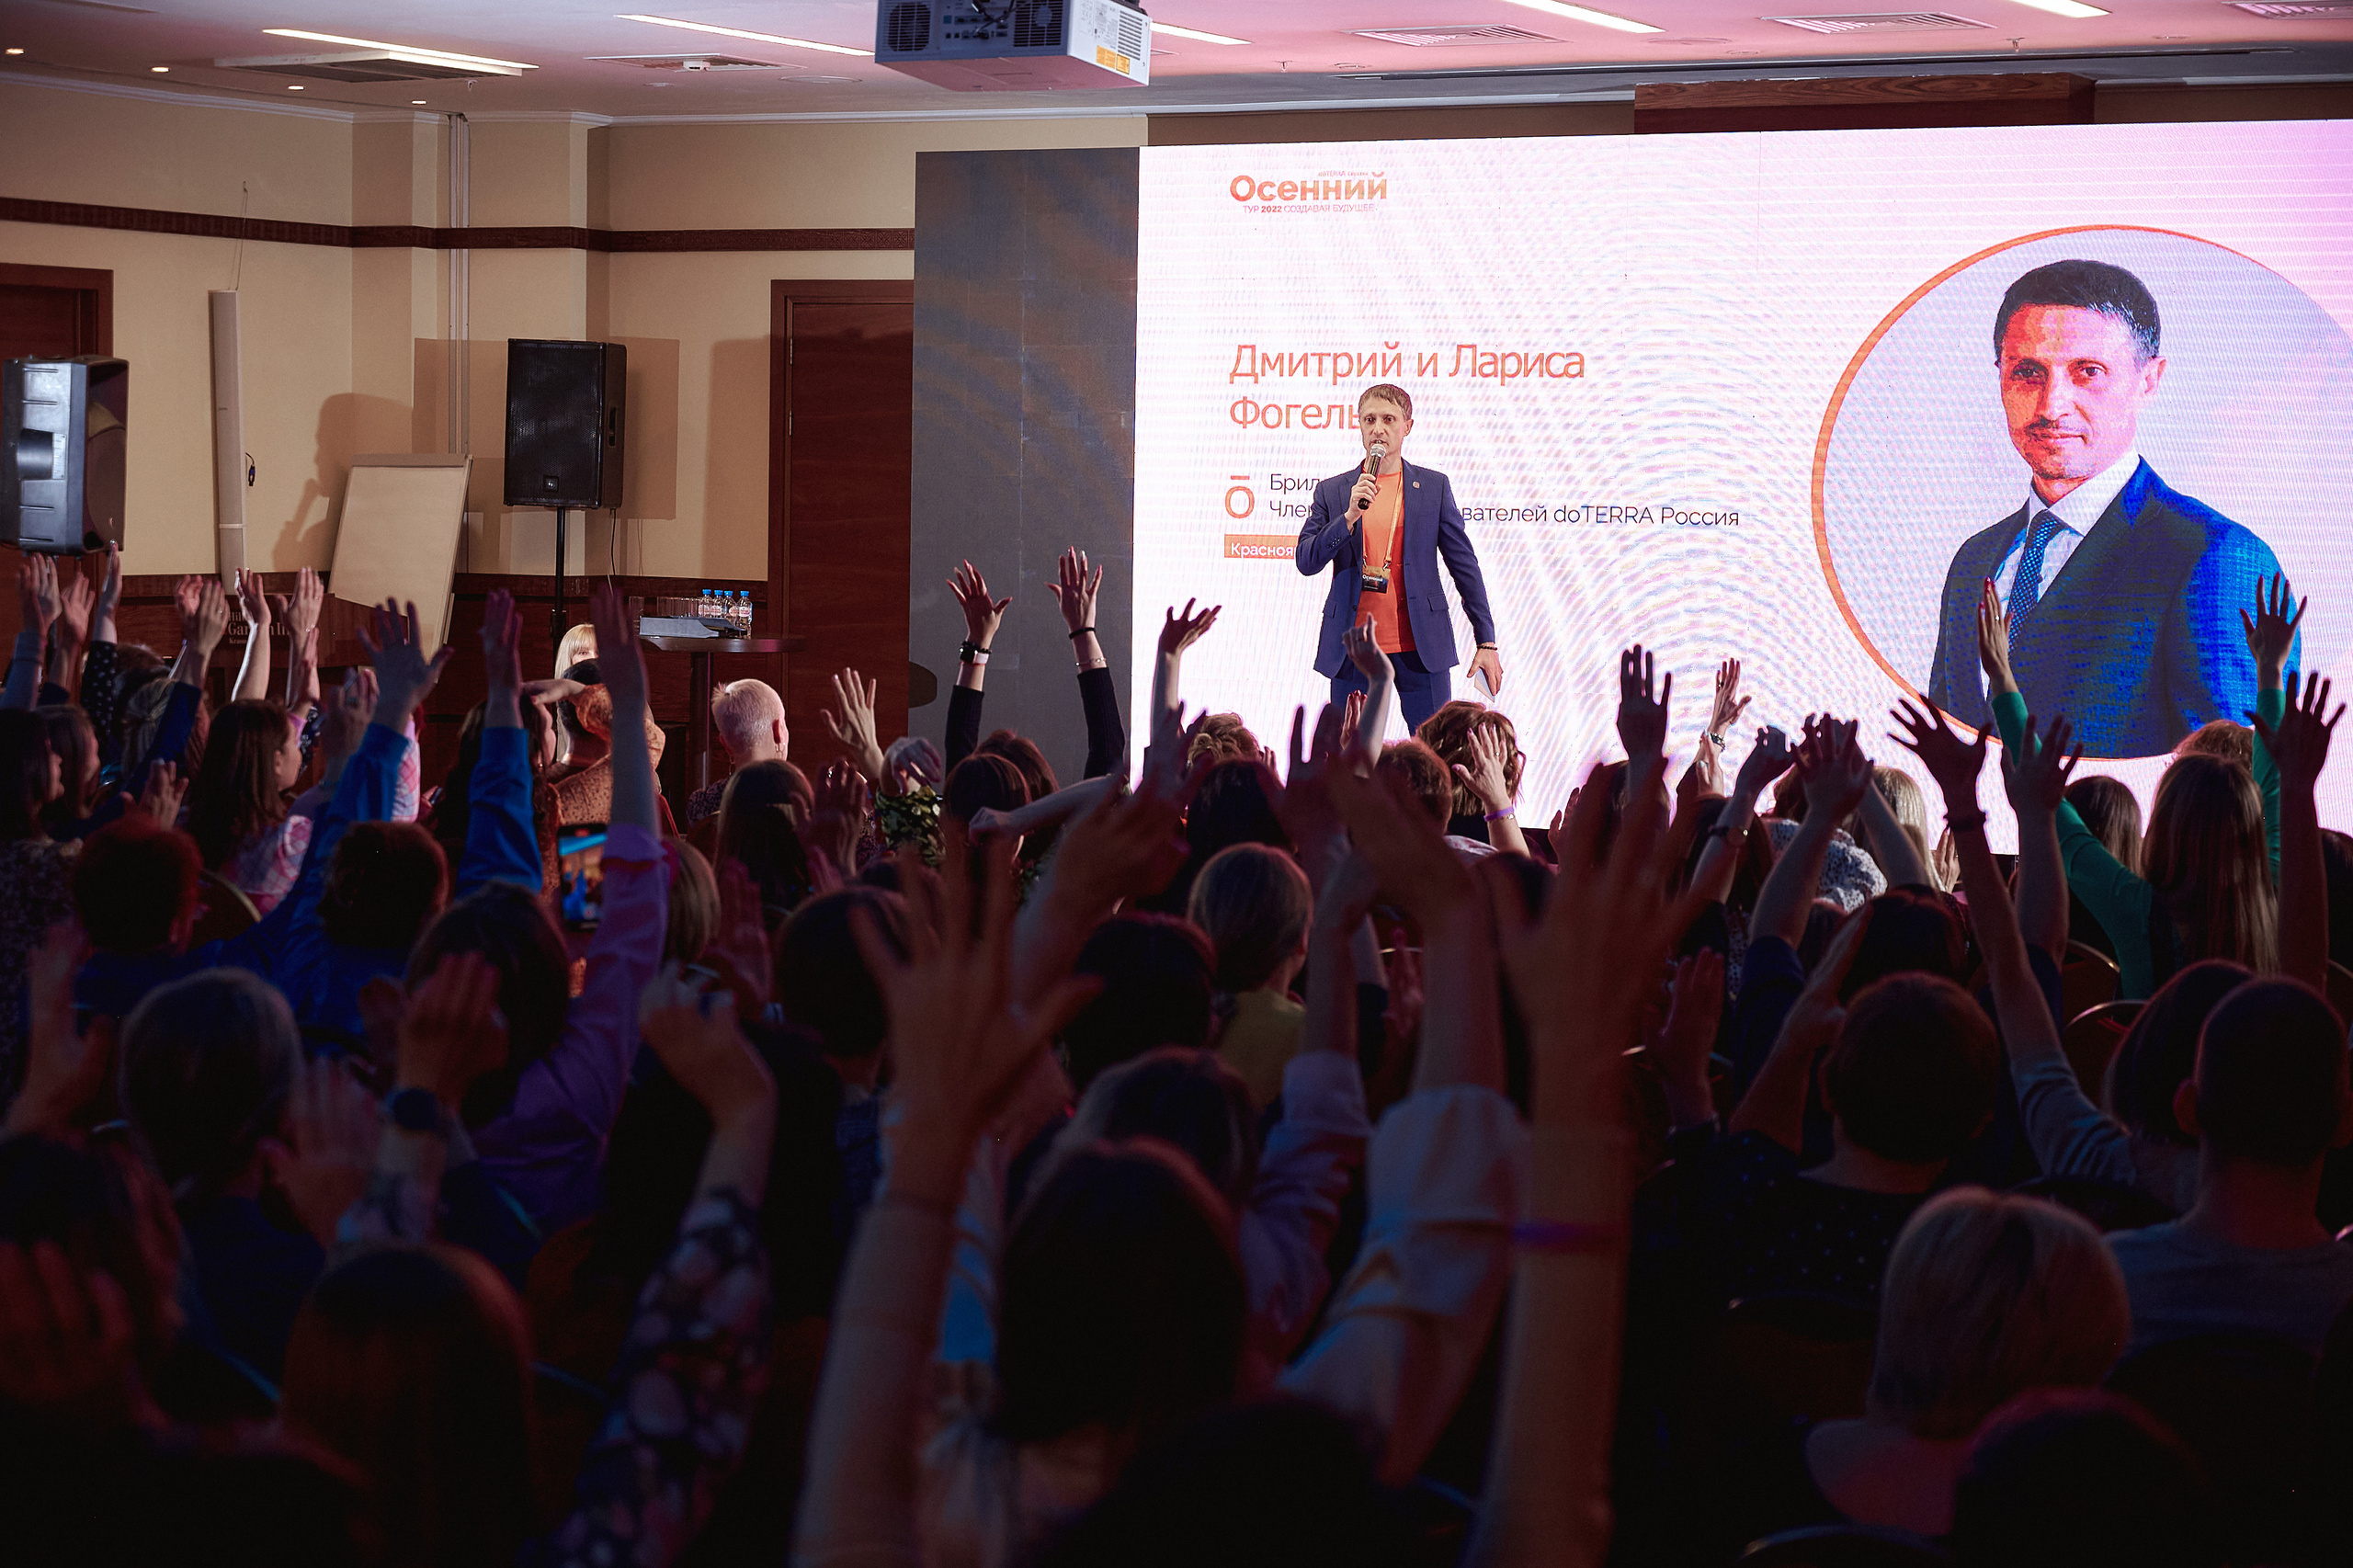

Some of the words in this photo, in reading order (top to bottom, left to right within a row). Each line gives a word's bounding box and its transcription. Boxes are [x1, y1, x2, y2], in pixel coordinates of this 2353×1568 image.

[1230, 171, 1387, 201] Осенний
[1243, 205, 1259, 213] ТУР
[1261, 205, 1282, 213] 2022
[1284, 204, 1331, 213] СОЗДАВАЯ
[1333, 203, 1374, 213] БУДУЩЕЕ
[1229, 341, 1403, 386] Дмитрий
[1418, 352, 1438, 378] и
[1449, 344, 1586, 387] Лариса
[1270, 473, 1321, 494] Брил
[1462, 505, 1547, 522] вателей
[1553, 505, 1654, 525] doTERRA
[1660, 506, 1740, 526] Россия
